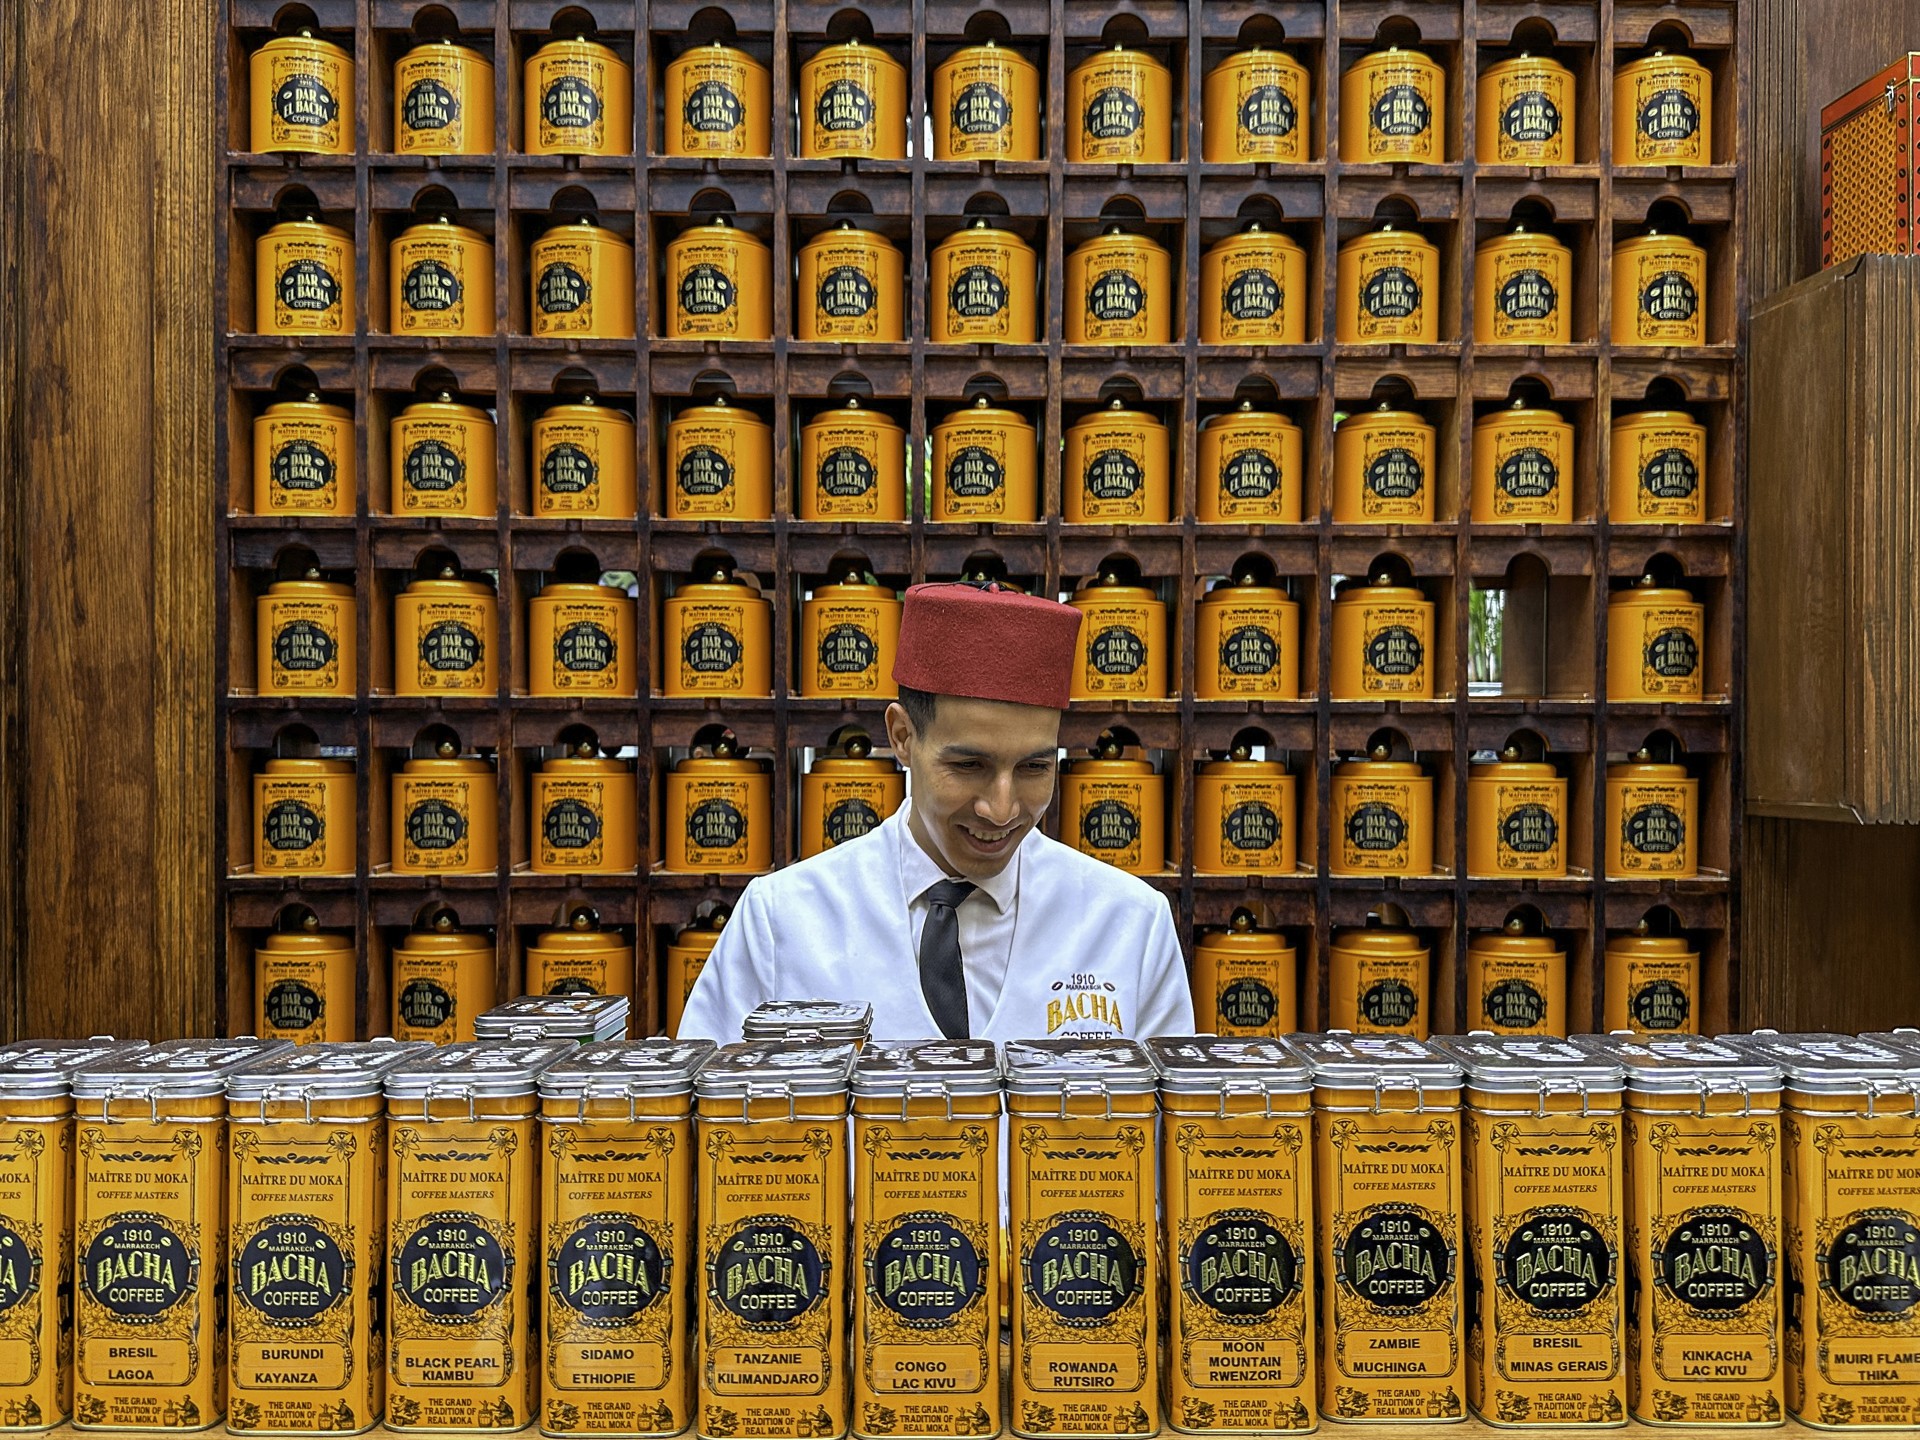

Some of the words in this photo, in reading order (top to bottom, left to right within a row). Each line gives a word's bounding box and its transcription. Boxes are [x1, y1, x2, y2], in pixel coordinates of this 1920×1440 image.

[296, 88, 316, 105] DAR
[833, 94, 853, 108] DAR
[284, 104, 294, 121] EL
[296, 104, 328, 121] BACHA
[823, 109, 833, 123] EL
[834, 106, 864, 125] BACHA
[1661, 104, 1681, 117] DAR
[292, 115, 320, 125] COFFEE
[830, 121, 856, 130] COFFEE
[1649, 119, 1659, 133] EL
[1661, 116, 1690, 134] BACHA
[1657, 129, 1684, 138] COFFEE
[419, 273, 438, 289] DAR
[409, 291, 418, 302] EL
[420, 288, 451, 304] BACHA
[1107, 283, 1126, 297] DAR
[416, 300, 442, 309] COFFEE
[1094, 298, 1104, 312] EL
[1107, 295, 1137, 312] BACHA
[1103, 309, 1128, 318] COFFEE
[837, 461, 855, 473] DAR
[1520, 462, 1539, 475] DAR
[825, 475, 835, 489] EL
[837, 472, 866, 490] BACHA
[1507, 477, 1516, 491] EL
[1518, 474, 1548, 491] BACHA
[832, 487, 858, 495] COFFEE
[1515, 488, 1542, 496] COFFEE
[576, 636, 596, 648] DAR
[564, 648, 575, 663] EL
[576, 647, 607, 664] BACHA
[572, 660, 599, 669] COFFEE
[1244, 815, 1263, 828] DAR
[1232, 829, 1242, 842] EL
[1243, 827, 1272, 842] BACHA
[1240, 839, 1266, 848] COFFEE
[1071, 974, 1095, 984] 1910
[1047, 992, 1123, 1034] BACHA
[1189, 1167, 1234, 1179] MAÎTRE
[1238, 1170, 1253, 1179] DU
[1257, 1170, 1290, 1179] MOKA
[1344, 1162, 1388, 1174] MAÎTRE
[1392, 1164, 1407, 1173] DU
[1411, 1164, 1444, 1173] MOKA
[1661, 1165, 1707, 1177] MAÎTRE
[1712, 1167, 1727, 1177] DU
[1732, 1167, 1764, 1176] MOKA
[88, 1170, 131, 1182] MAÎTRE
[135, 1173, 150, 1183] DU
[155, 1174, 188, 1183] MOKA
[242, 1173, 286, 1185] MAÎTRE
[290, 1176, 305, 1185] DU
[310, 1176, 342, 1185] MOKA
[402, 1169, 446, 1182] MAÎTRE
[450, 1172, 466, 1182] DU
[470, 1172, 503, 1182] MOKA
[873, 1169, 919, 1181] MAÎTRE
[923, 1172, 938, 1181] DU
[943, 1171, 976, 1181] MOKA
[97, 1191, 132, 1199] COFFEE
[1711, 1185, 1756, 1193] MASTERS
[1380, 1221, 1410, 1232] 1910
[1542, 1224, 1571, 1235] 1910
[1700, 1224, 1730, 1235] 1910
[1866, 1226, 1896, 1238] 1910
[123, 1230, 151, 1241] 1910
[278, 1232, 306, 1244] 1910
[437, 1229, 466, 1241] 1910
[596, 1231, 624, 1242] 1910
[753, 1233, 783, 1245] 1910
[911, 1230, 941, 1242] 1910
[1068, 1230, 1098, 1241] 1910
[1226, 1228, 1256, 1239] 1910
[1356, 1242, 1437, 1285] BACHA
[1516, 1246, 1597, 1288] BACHA
[1674, 1245, 1757, 1288] BACHA
[1840, 1247, 1920, 1291] BACHA
[97, 1250, 176, 1292] BACHA
[250, 1252, 331, 1295] BACHA
[411, 1251, 492, 1292] BACHA
[569, 1251, 650, 1295] BACHA
[726, 1255, 808, 1298] BACHA
[884, 1252, 966, 1295] BACHA
[1042, 1252, 1124, 1295] BACHA
[1201, 1250, 1284, 1293] BACHA
[1369, 1280, 1424, 1294] COFFEE
[1530, 1283, 1586, 1297] COFFEE
[1688, 1283, 1744, 1297] COFFEE
[1854, 1286, 1910, 1300] COFFEE
[110, 1288, 164, 1302] COFFEE
[264, 1292, 319, 1305] COFFEE
[424, 1288, 479, 1302] COFFEE
[582, 1291, 637, 1305] COFFEE
[898, 1292, 954, 1306] COFFEE
[1056, 1291, 1112, 1304] COFFEE
[1215, 1288, 1271, 1302] COFFEE
[740, 1294, 796, 1309] COFFEE
[1223, 1340, 1264, 1352] MOON
[1370, 1339, 1420, 1349] ZAMBIE
[1533, 1338, 1581, 1348] BRESIL
[110, 1348, 157, 1357] BRESIL
[262, 1349, 323, 1359] BURUNDI
[582, 1350, 634, 1359] SIDAMO
[1683, 1351, 1752, 1361] KINKACHA
[406, 1358, 450, 1368] BLACK
[455, 1358, 499, 1368] PEARL
[736, 1354, 801, 1364] TANZANIE
[1209, 1357, 1281, 1367] MOUNTAIN
[1835, 1354, 1872, 1364] MUIRI
[895, 1362, 946, 1372] CONGO
[1050, 1362, 1118, 1373] ROWANDA
[1354, 1362, 1426, 1372] MUCHINGA
[1511, 1362, 1553, 1371] MINAS
[1558, 1361, 1607, 1371] GERAIS
[1684, 1366, 1710, 1375] LAC
[1715, 1366, 1746, 1375] KIVU
[109, 1370, 153, 1379] LAGOA
[256, 1373, 318, 1383] KAYANZA
[423, 1371, 473, 1380] KIAMBU
[573, 1374, 635, 1383] ETHIOPIE
[718, 1374, 819, 1384] KILIMANDJARO
[1210, 1370, 1281, 1381] RWENZORI
[1858, 1370, 1899, 1382] THIKA
[893, 1379, 919, 1388] LAC
[924, 1378, 955, 1388] KIVU
[1054, 1377, 1114, 1386] RUTSIRO
[1696, 1393, 1711, 1401] THE
[110, 1406, 150, 1414] TRADITION
[1691, 1402, 1732, 1410] TRADITION
[1734, 1402, 1744, 1410] OF
[1695, 1411, 1713, 1420] REAL
[1717, 1411, 1742, 1420] MOKA
[904, 1424, 922, 1432] REAL
[926, 1424, 950, 1432] MOKA
